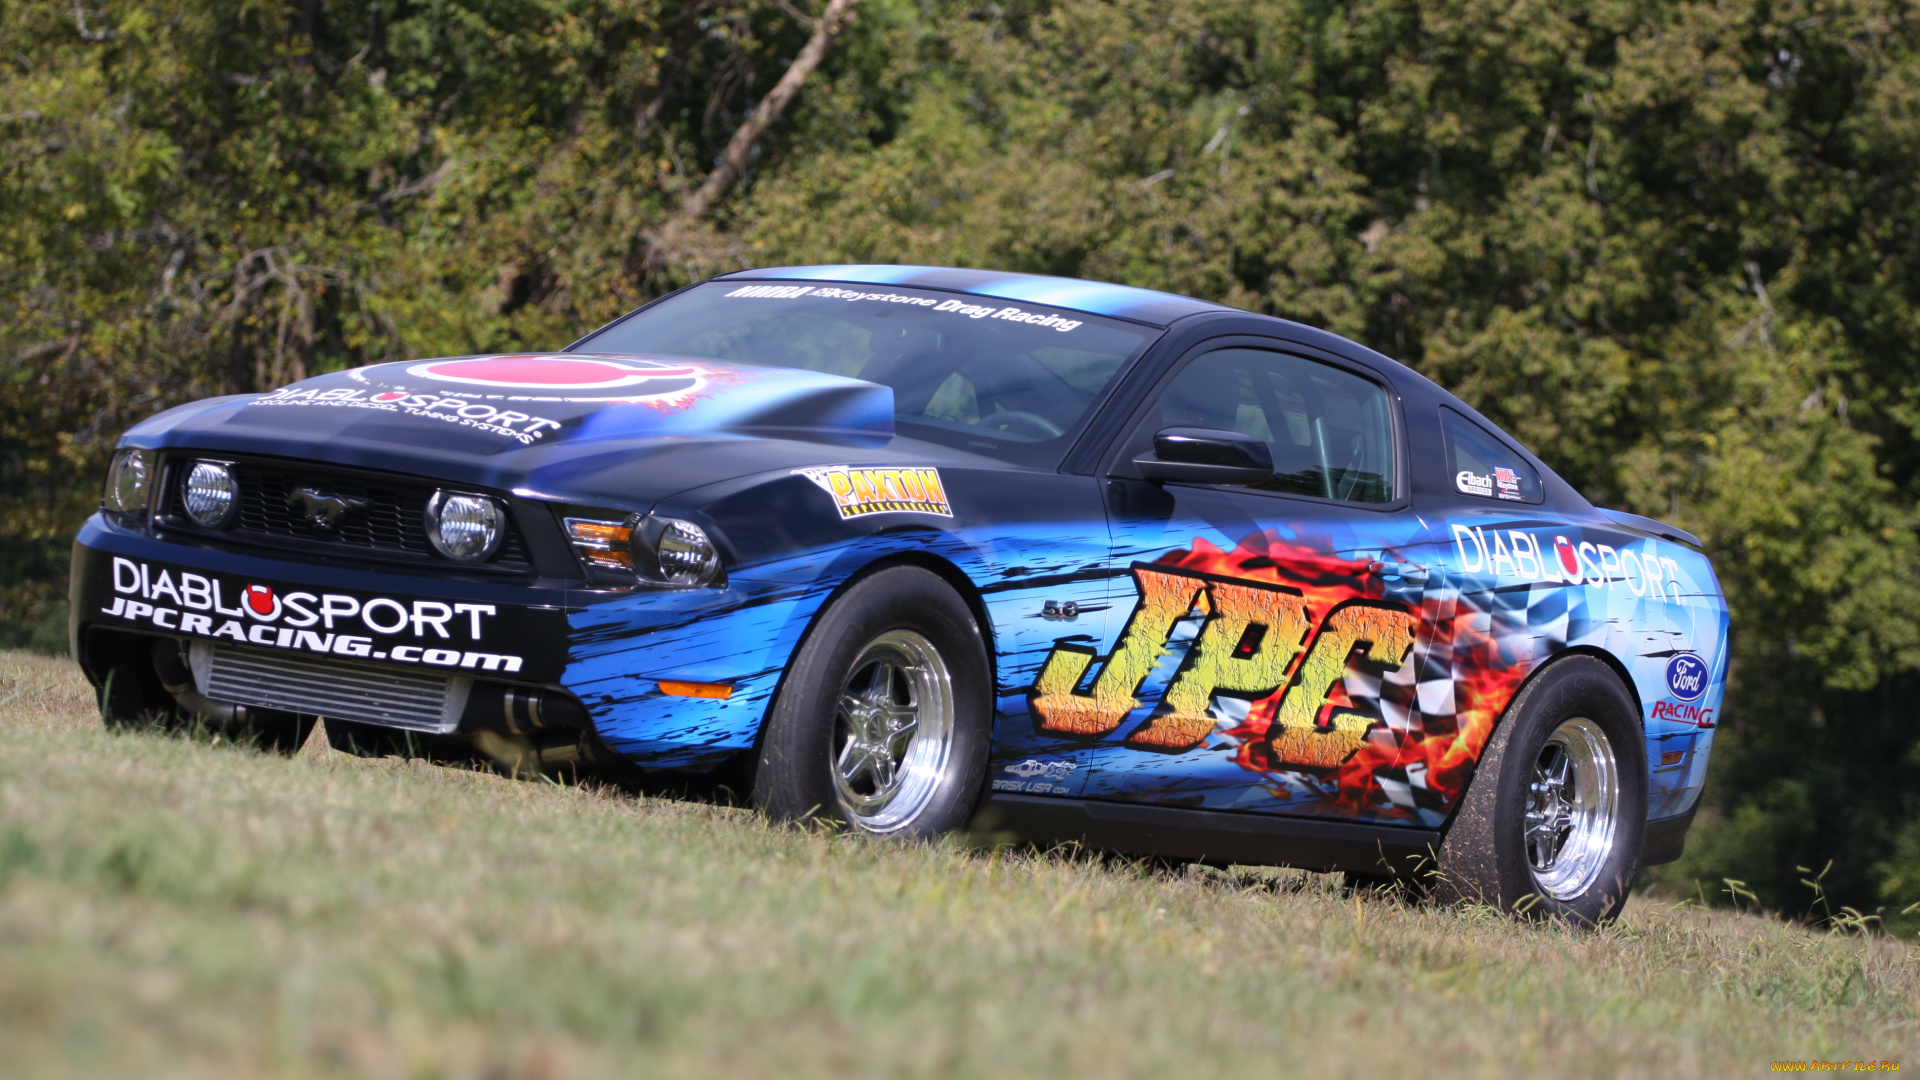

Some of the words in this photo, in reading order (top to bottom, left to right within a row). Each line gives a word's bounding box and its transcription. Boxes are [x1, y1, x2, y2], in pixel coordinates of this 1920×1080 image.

[823, 287, 937, 306] Keystone
[933, 299, 996, 319] Drag
[992, 307, 1083, 332] Racing
[257, 388, 561, 433] DIABLOSPORT
[313, 399, 347, 407] AND
[347, 400, 399, 412] DIESEL
[404, 406, 459, 423] TUNING
[459, 418, 534, 445] SYSTEMS
[828, 468, 947, 507] PAXTON
[1456, 470, 1493, 489] Eibach
[842, 501, 946, 516] SUPERCHARGERS
[1451, 523, 1682, 606] DIABLOSPORT
[112, 556, 497, 640] DIABLOSPORT
[101, 597, 523, 673] JPCRACING.com
[1027, 561, 1416, 771] JPC
[1673, 659, 1702, 692] Ford
[1651, 700, 1714, 727] RACING
